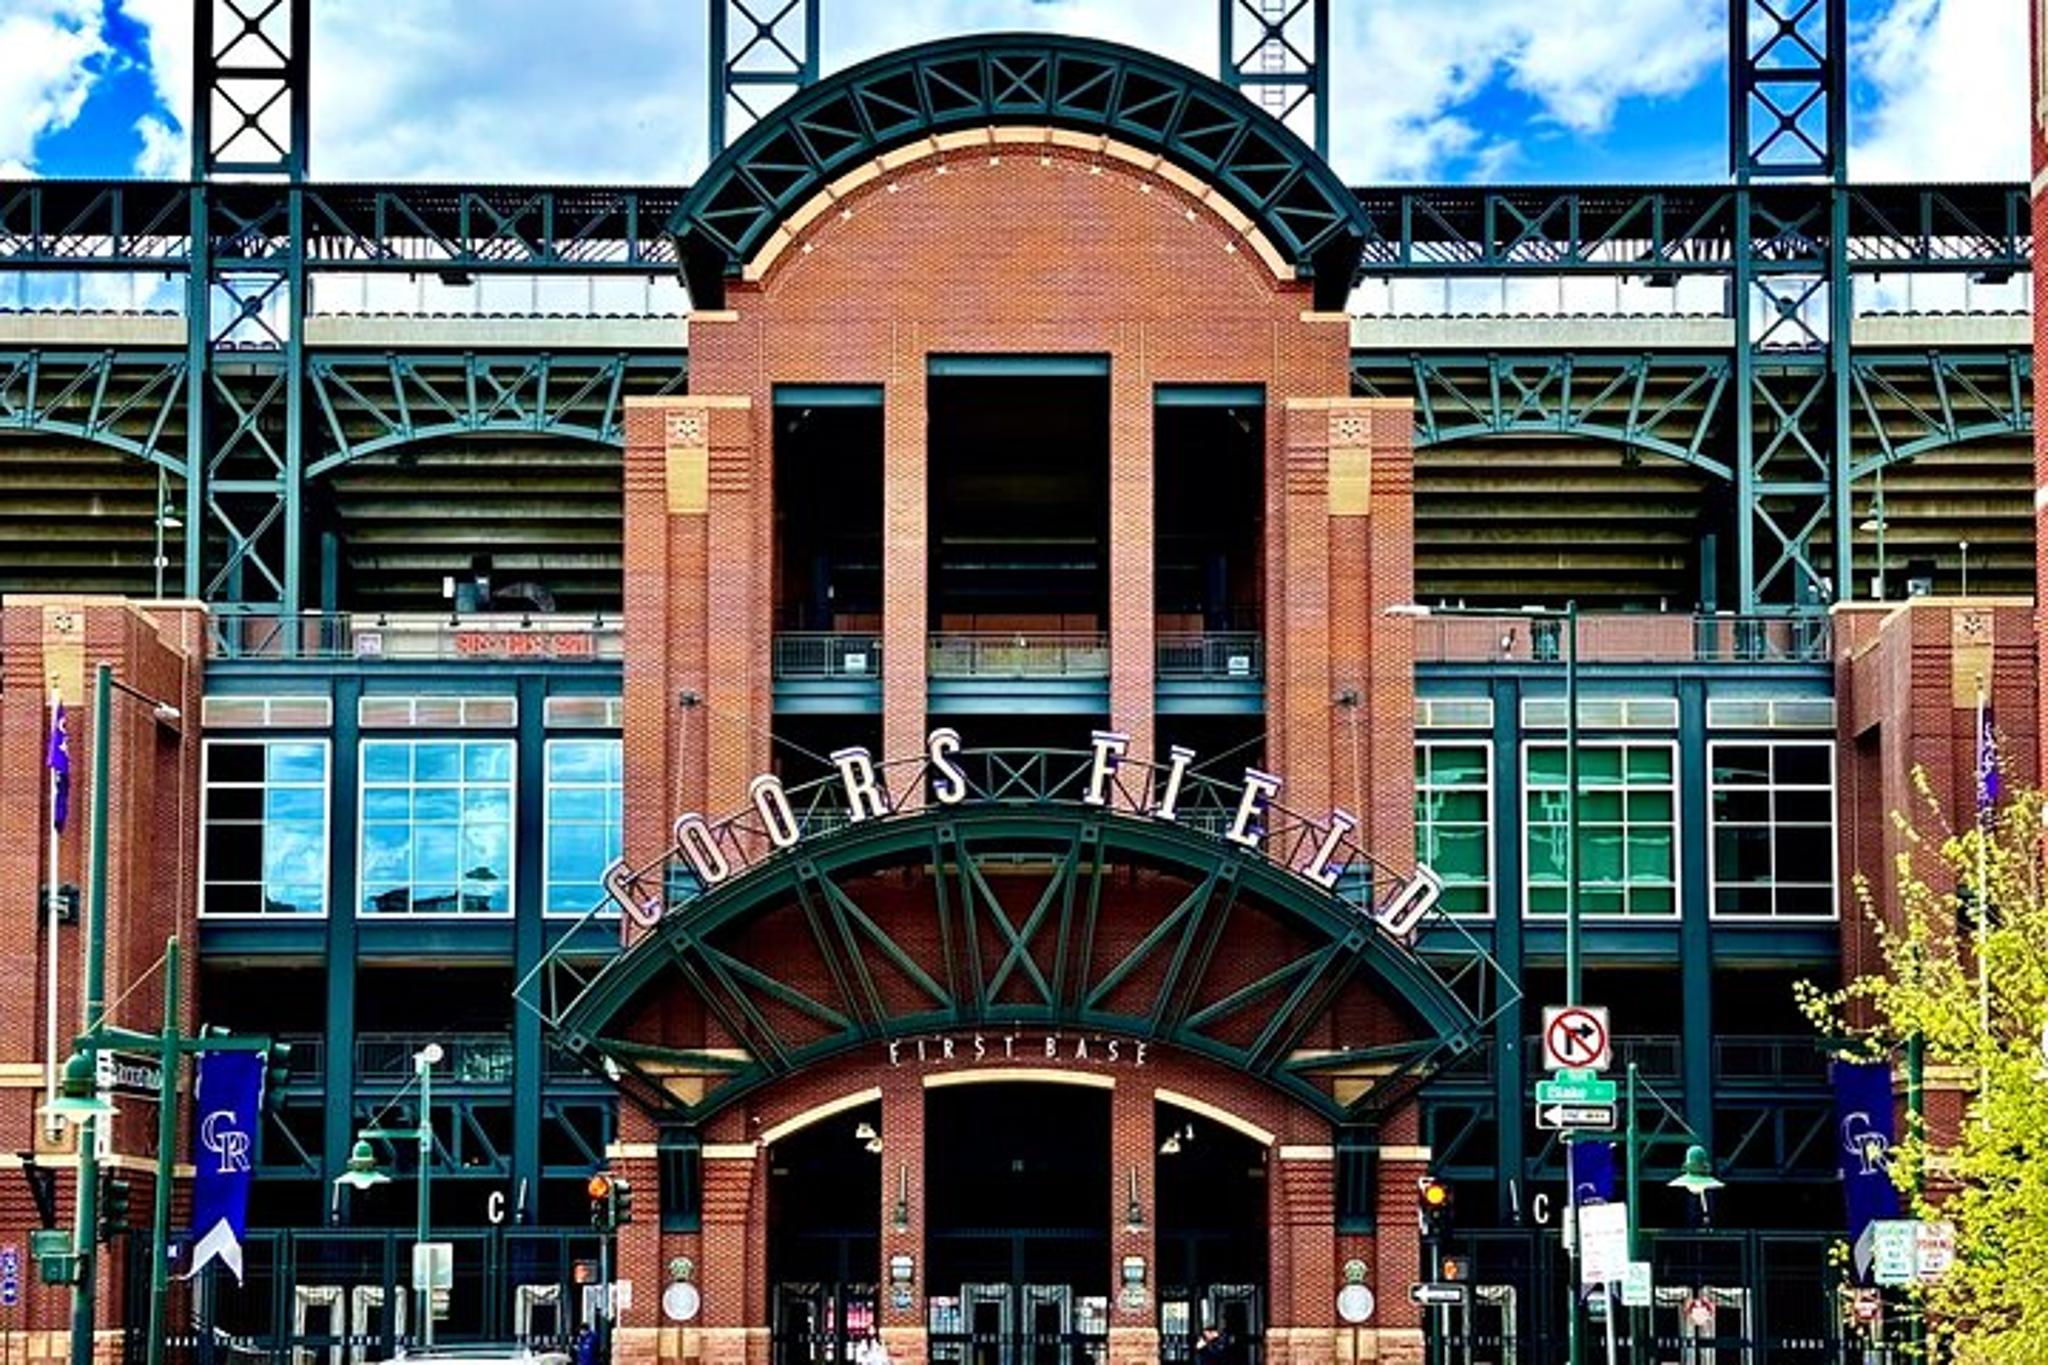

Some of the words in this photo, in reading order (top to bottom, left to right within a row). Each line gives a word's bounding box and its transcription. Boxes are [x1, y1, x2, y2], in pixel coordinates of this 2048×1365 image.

[602, 727, 966, 927] COORS
[1083, 729, 1446, 937] FIELD
[889, 1036, 1014, 1067] FIRST
[1045, 1037, 1148, 1065] BASE
[201, 1111, 251, 1172] CR
[488, 1190, 505, 1224] C
[1533, 1193, 1549, 1224] C
